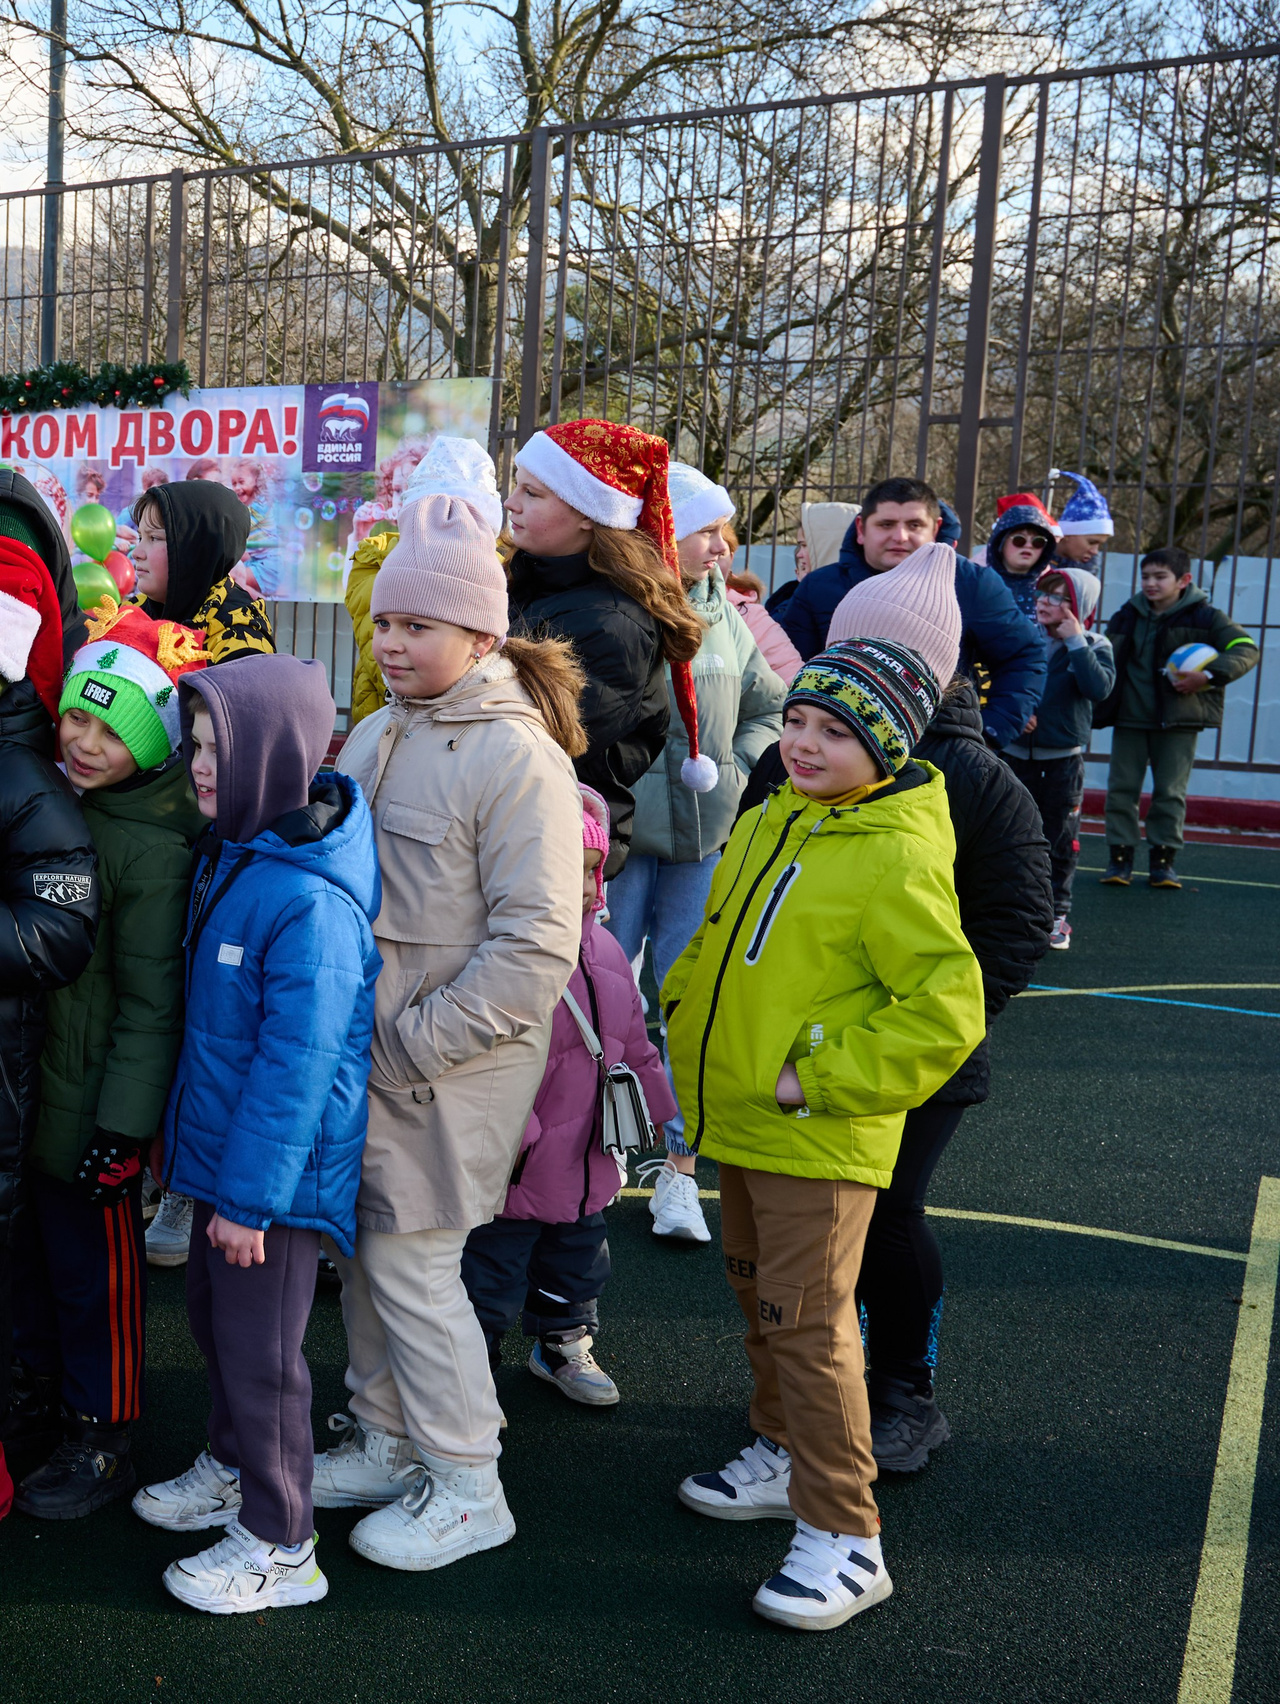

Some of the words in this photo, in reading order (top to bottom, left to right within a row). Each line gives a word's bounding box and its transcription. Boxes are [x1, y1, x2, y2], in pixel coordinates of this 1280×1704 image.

[111, 406, 298, 467] ДВОРА!
[317, 442, 362, 453] ЕДИНАЯ
[317, 453, 361, 463] РОССИЯ
[725, 1254, 757, 1279] EEN
